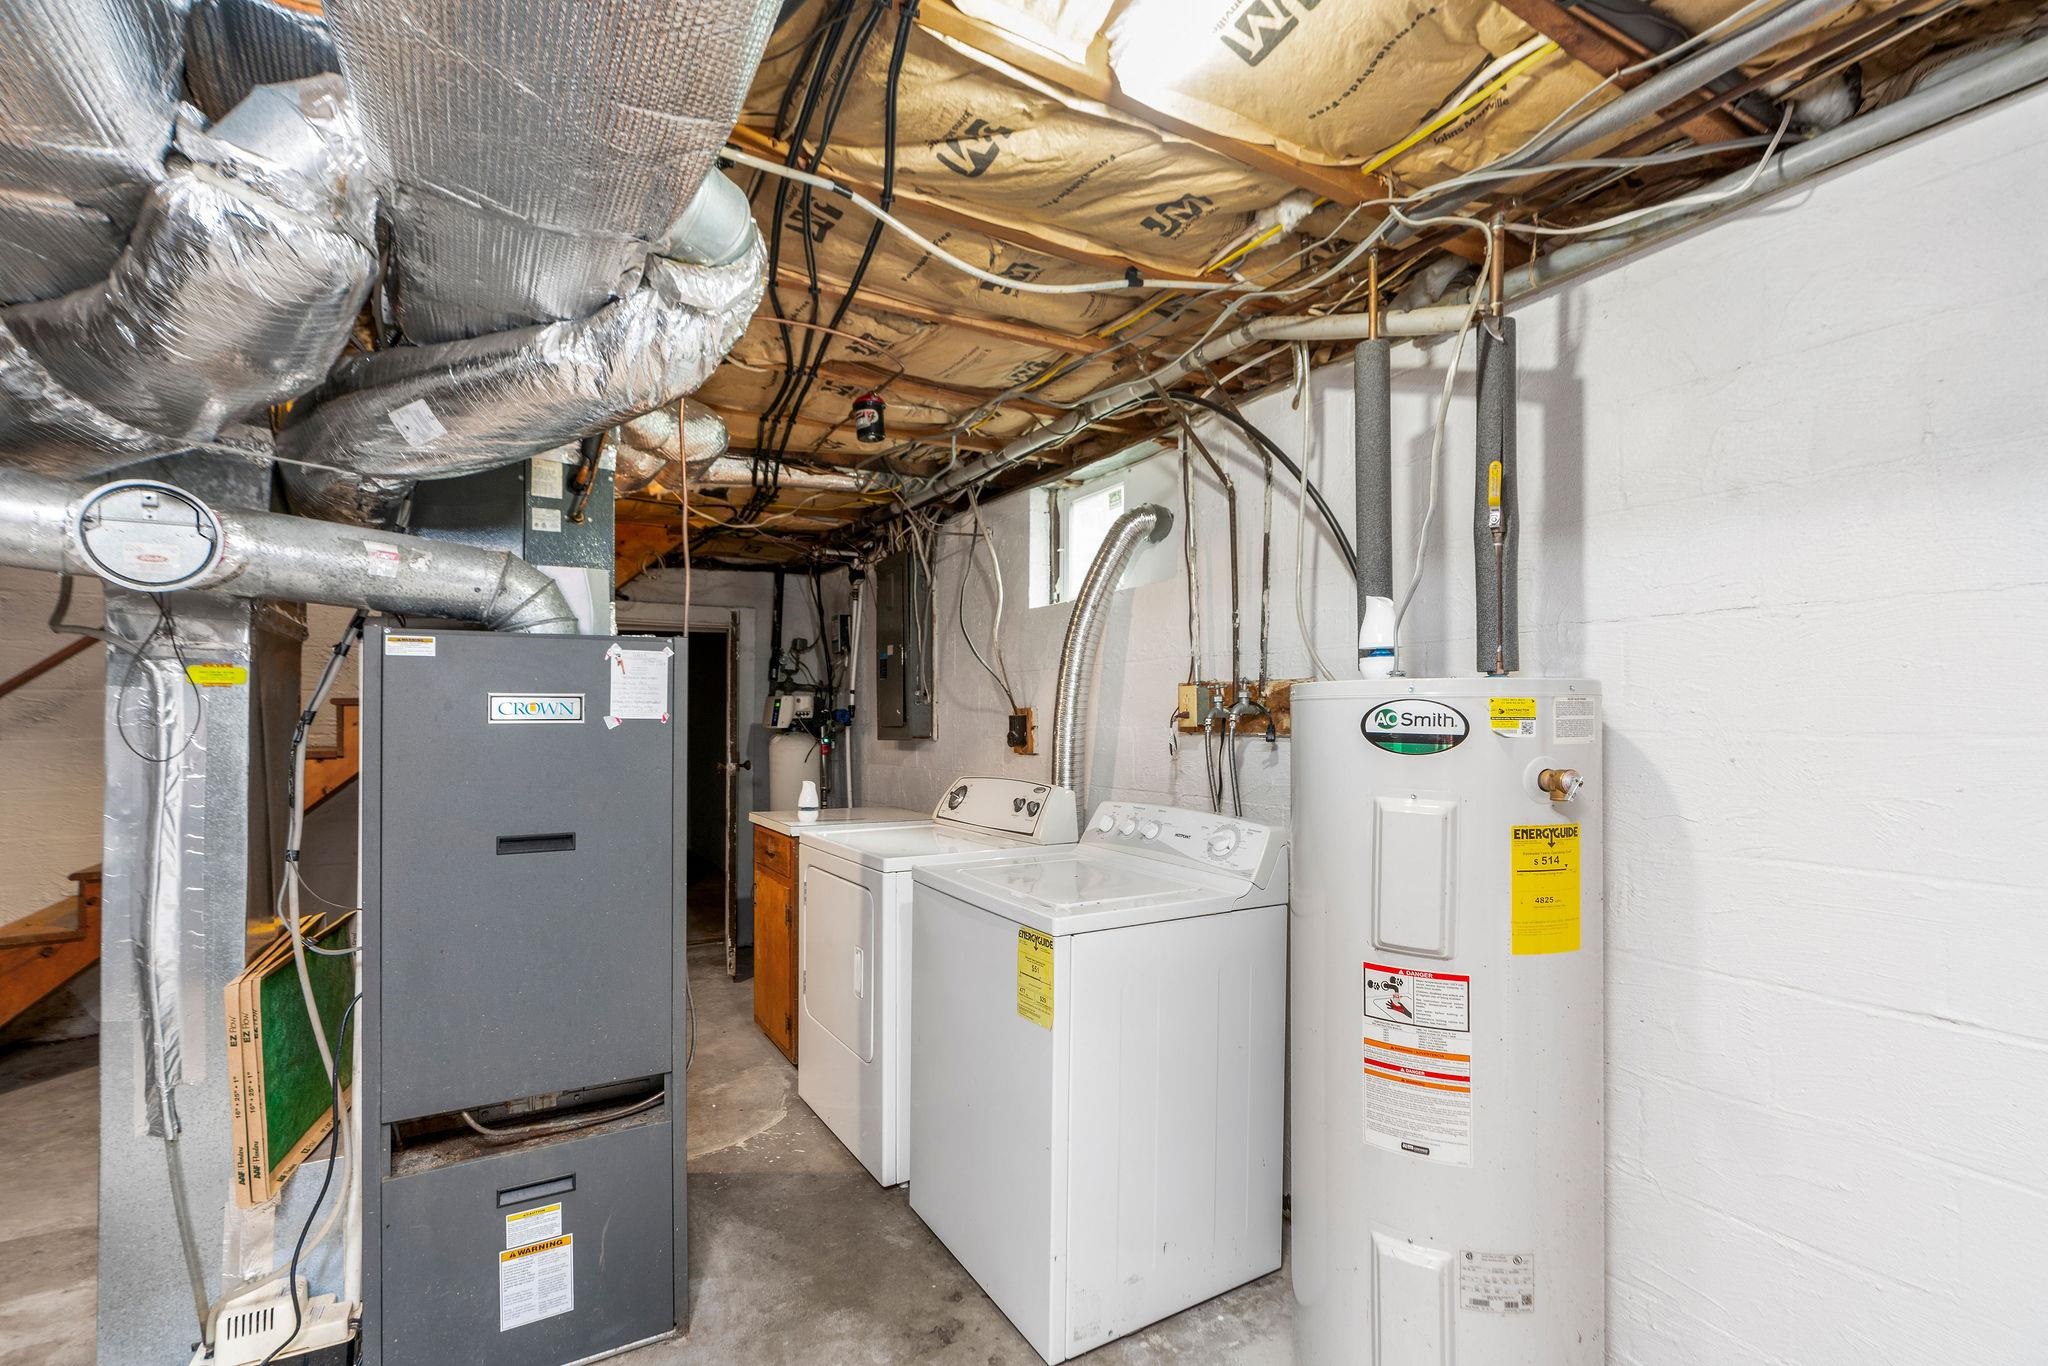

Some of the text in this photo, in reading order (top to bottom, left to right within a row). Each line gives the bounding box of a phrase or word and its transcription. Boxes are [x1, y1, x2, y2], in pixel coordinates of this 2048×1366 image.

[498, 702, 575, 716] CROWN
[1401, 712, 1455, 728] Smith
[1513, 826, 1579, 842] ENERGYGUIDE
[1018, 929, 1054, 950] ENERGYGUIDE
[1406, 970, 1434, 979] DANGER
[229, 1034, 238, 1047] EZ
[242, 1030, 251, 1043] EZ
[238, 1171, 247, 1186] AAF
[252, 1165, 262, 1180] AAF
[517, 1239, 563, 1257] WARNING
